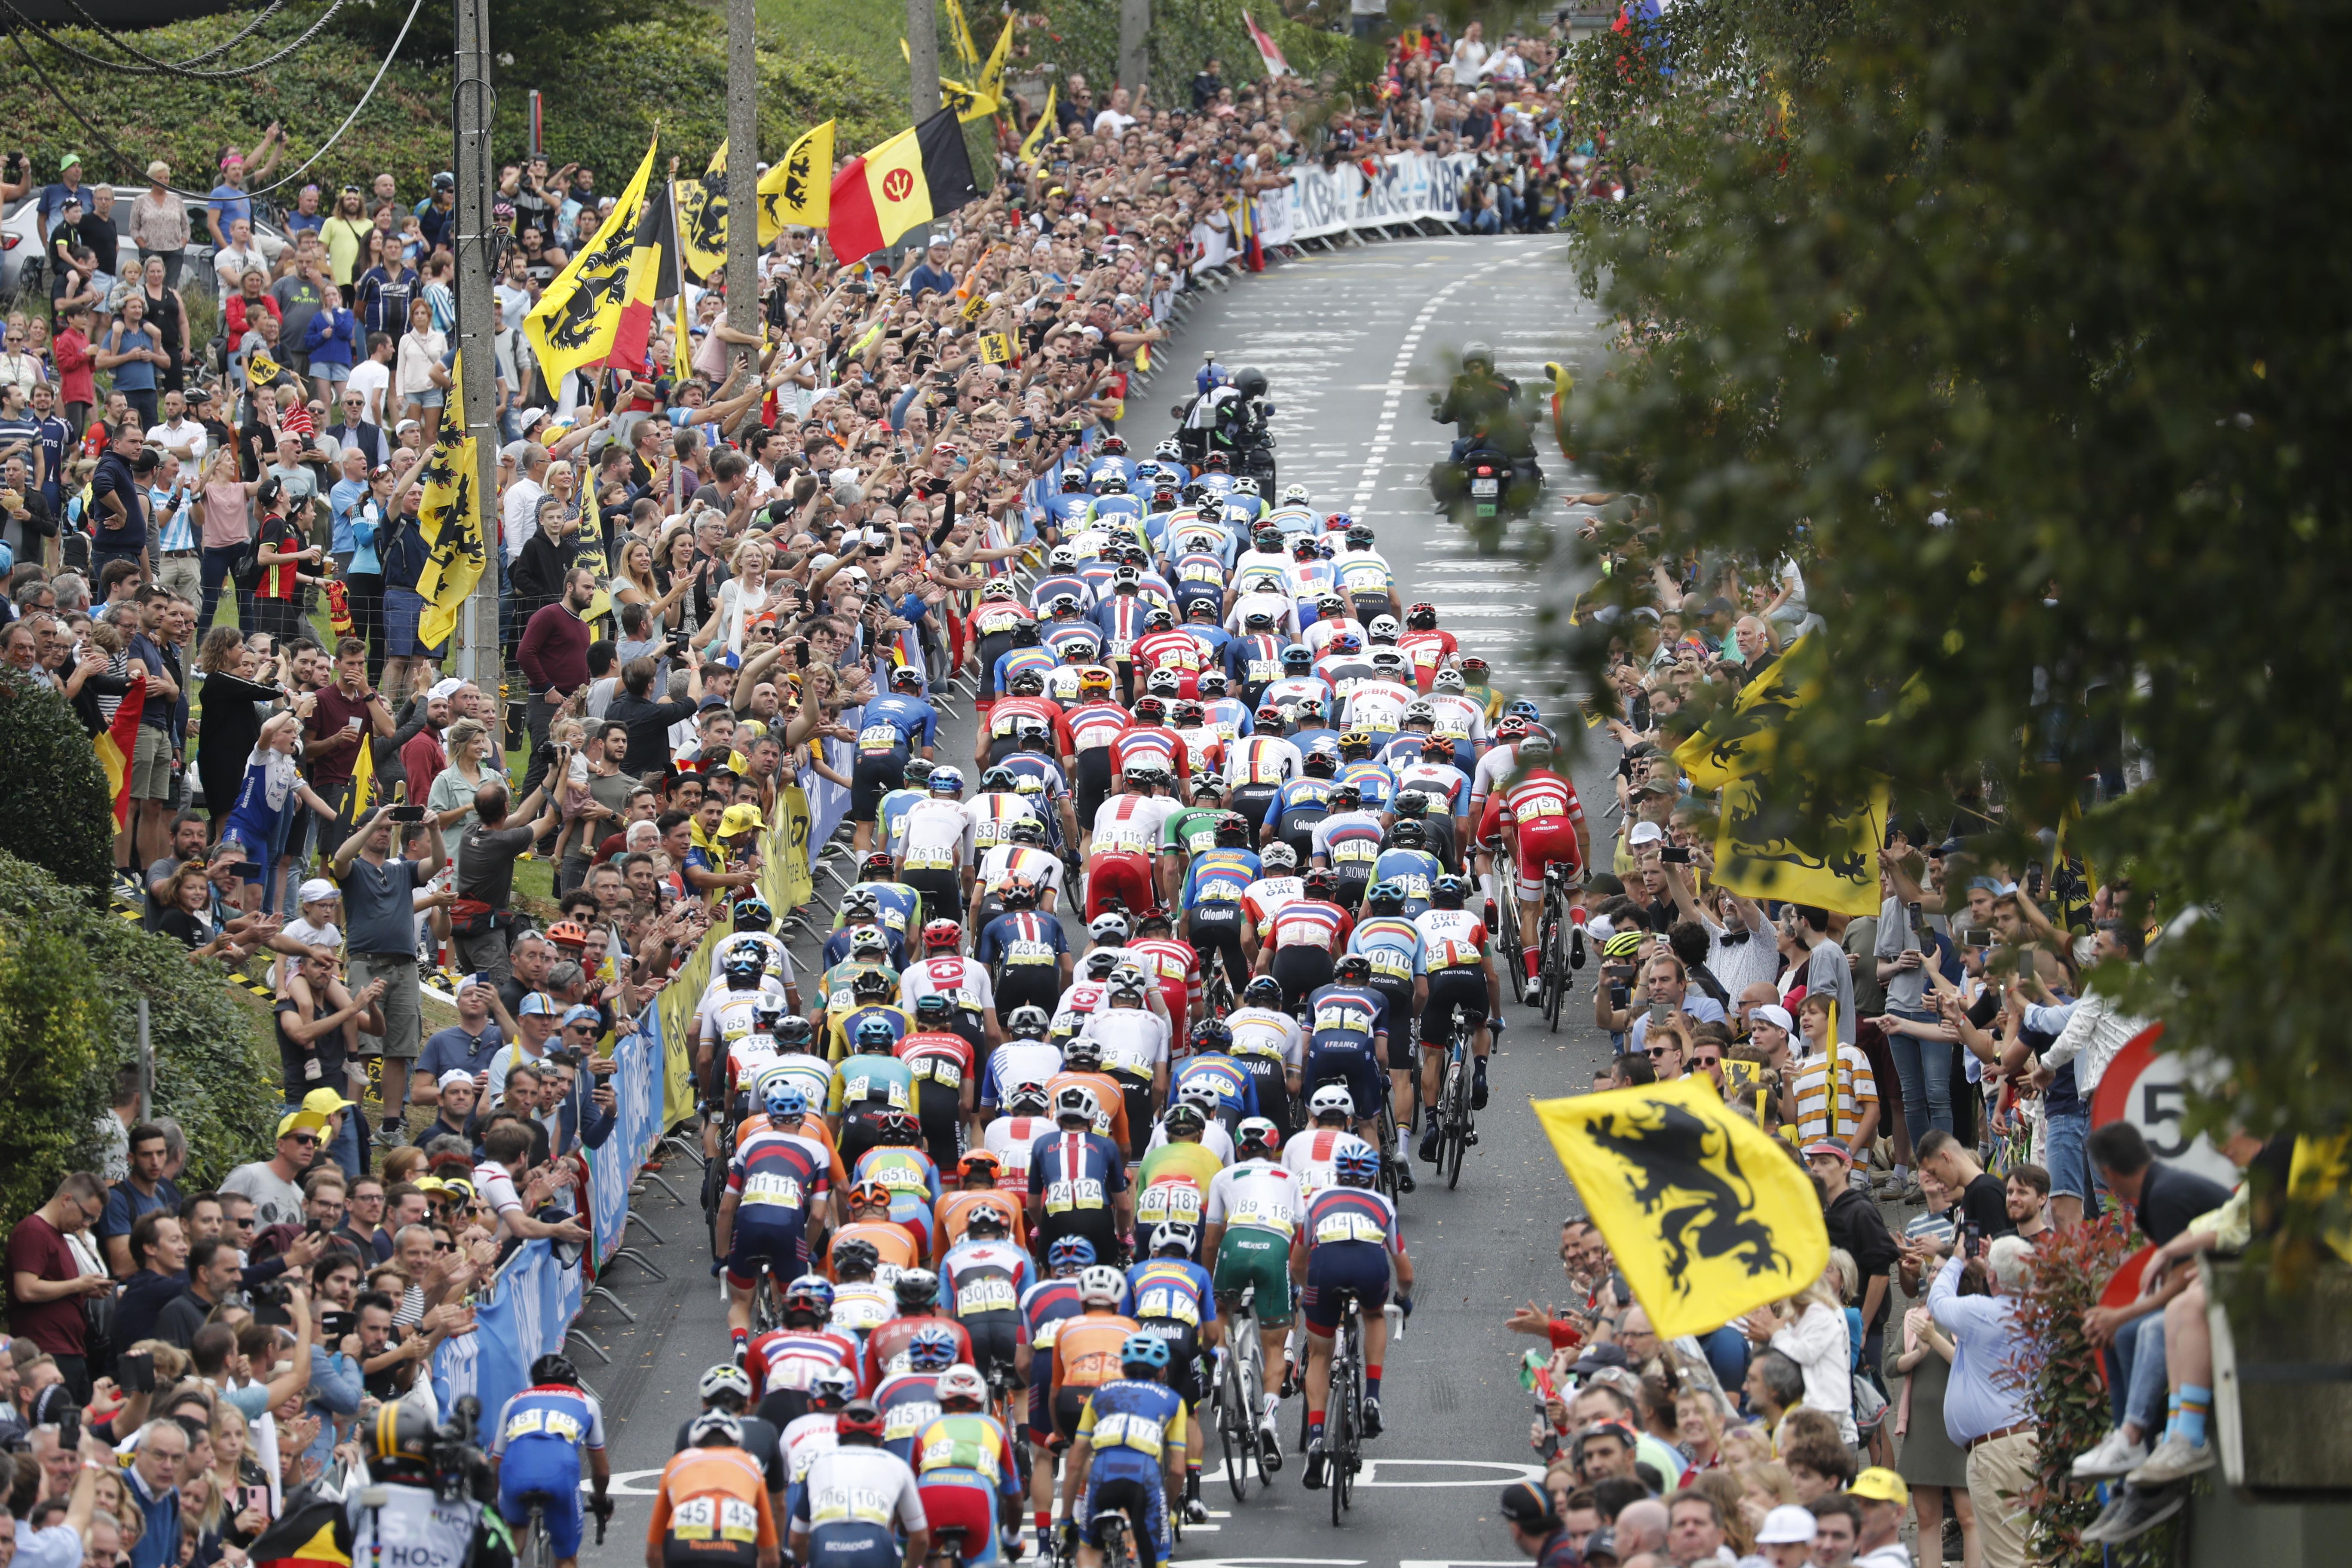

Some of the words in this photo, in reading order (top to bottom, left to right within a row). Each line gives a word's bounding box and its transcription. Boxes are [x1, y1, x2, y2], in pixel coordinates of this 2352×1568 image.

[1066, 519, 1077, 529] 26
[1191, 564, 1197, 573] 9
[1212, 568, 1218, 576] 9
[1349, 577, 1365, 586] 72
[1373, 576, 1387, 585] 72
[1106, 600, 1143, 612] USA
[984, 616, 1001, 627] 136
[1247, 635, 1284, 645] USA
[1162, 651, 1177, 662] 52
[1183, 650, 1198, 661] 52
[1250, 662, 1269, 673] 125
[1060, 680, 1077, 690] 85
[995, 701, 1044, 709] AUSTRIA
[1356, 713, 1370, 724] 41
[1380, 713, 1395, 723] 41
[1451, 721, 1466, 732] 40
[862, 729, 877, 741] 27
[878, 728, 894, 739] 27
[1190, 752, 1204, 765] 96
[1263, 766, 1279, 776] 84
[1345, 764, 1380, 773] Colombiana
[242, 776, 256, 808] deceuninck
[1519, 801, 1534, 815] 57
[1541, 797, 1557, 808] 57
[914, 802, 968, 818] ATVIA
[977, 825, 994, 837] 83
[1191, 833, 1213, 844] 145
[908, 846, 927, 859] 176
[930, 846, 952, 859] 176
[1335, 842, 1359, 853] 160
[1205, 852, 1245, 861] Colombiana
[1344, 866, 1372, 879] SLOVAK
[1412, 879, 1429, 891] 20
[1266, 888, 1295, 897] GAL
[888, 909, 905, 924] 23
[1200, 908, 1234, 921] Colombia
[1005, 917, 1048, 926] USA
[1431, 921, 1460, 930] GAL
[1009, 943, 1030, 954] 123
[1458, 943, 1477, 954] 95
[1393, 954, 1411, 970] 10
[1427, 949, 1445, 963] 95
[1166, 958, 1183, 972] 51
[1369, 977, 1398, 985] eobank
[961, 992, 980, 1008] 91
[1093, 1013, 1159, 1027] LATVIA
[1323, 1009, 1332, 1020] 2
[1354, 1012, 1362, 1023] 2
[726, 1017, 746, 1031] 65
[1054, 1015, 1070, 1027] 89
[904, 1036, 965, 1047] AUSTRIA
[1329, 1041, 1358, 1049] FRANCE
[938, 1063, 961, 1082] 138
[1213, 1076, 1233, 1089] 78
[2143, 1084, 2191, 1158] 5
[955, 1120, 963, 1159] AUSTRIA
[1047, 1142, 1099, 1154] USA
[773, 1179, 797, 1194] 111
[1075, 1182, 1101, 1198] 124
[1047, 1184, 1071, 1202] 124
[1142, 1192, 1166, 1210] 187
[1173, 1193, 1198, 1210] 187
[1234, 1200, 1258, 1215] 189
[1321, 1214, 1347, 1231] 114
[1237, 1240, 1271, 1250] MEXICO
[1145, 1263, 1189, 1273] Colombiana
[959, 1286, 983, 1305] 130
[989, 1283, 1014, 1299] 130
[1142, 1291, 1163, 1306] 77
[1178, 1295, 1196, 1315] 77
[1142, 1323, 1183, 1340] Colombia
[1099, 1380, 1170, 1400] UKRAINE
[888, 1407, 915, 1427] 115
[927, 1472, 974, 1484] ERITREA
[680, 1503, 707, 1524] 45
[728, 1503, 754, 1527] 45
[1158, 1486, 1169, 1545] UKRAINE
[689, 1539, 739, 1553] TeamNL
[824, 1539, 874, 1552] ECUADOR
